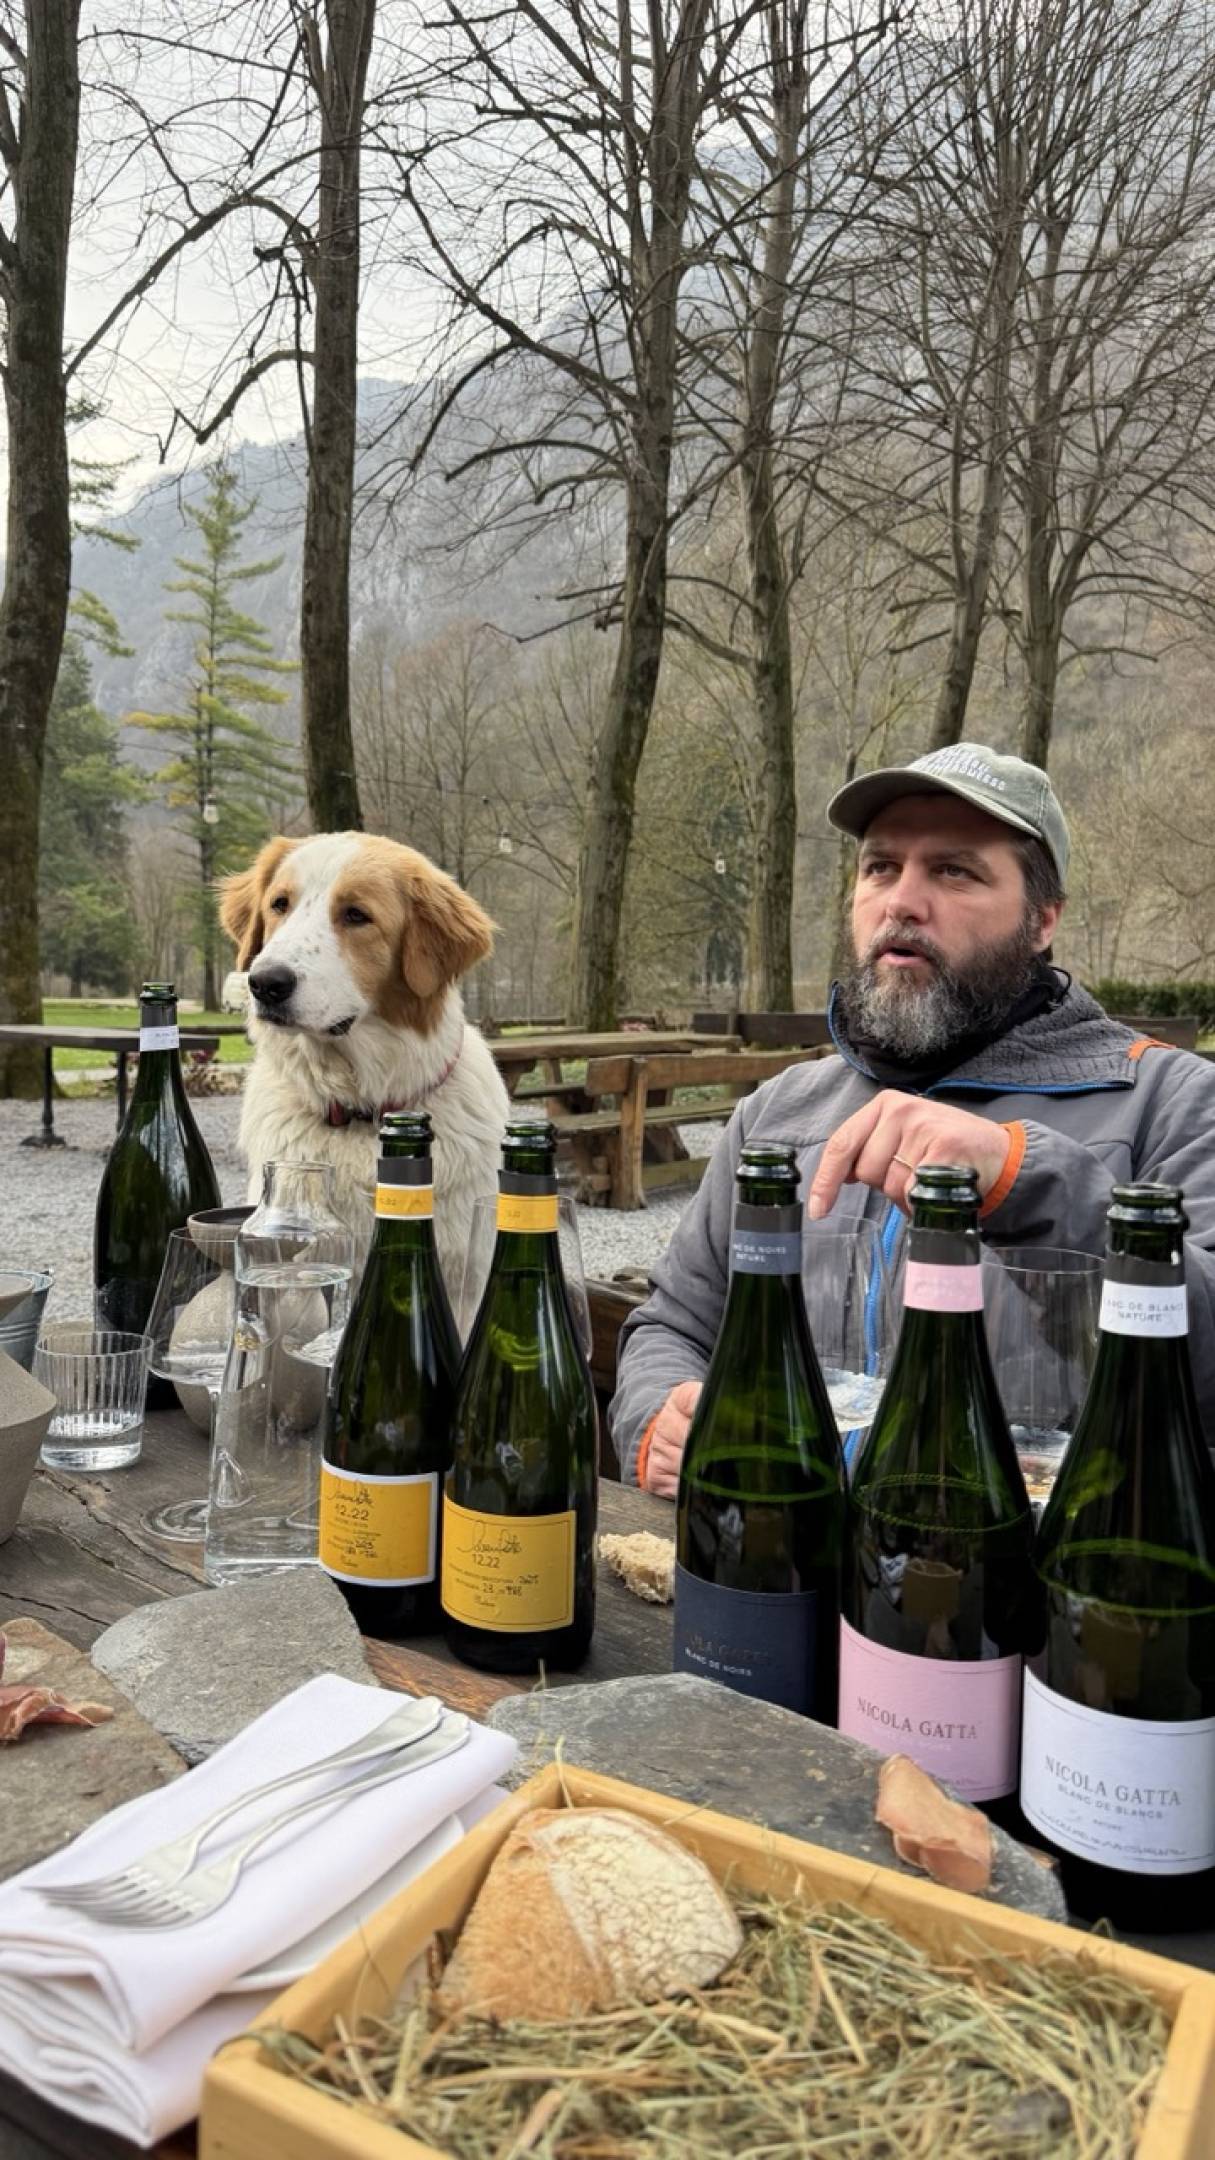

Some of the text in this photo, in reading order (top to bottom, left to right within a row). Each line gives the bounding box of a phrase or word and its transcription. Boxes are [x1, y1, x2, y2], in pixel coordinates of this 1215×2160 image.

[1118, 1311, 1163, 1323] NATURE
[1128, 1301, 1143, 1311] DE
[1147, 1302, 1184, 1312] BLANC
[857, 1696, 978, 1740] NICOLA GATTA
[1044, 1753, 1182, 1807] NICOLA GATTA
[1057, 1782, 1164, 1820] BLANC DE BLANCS
